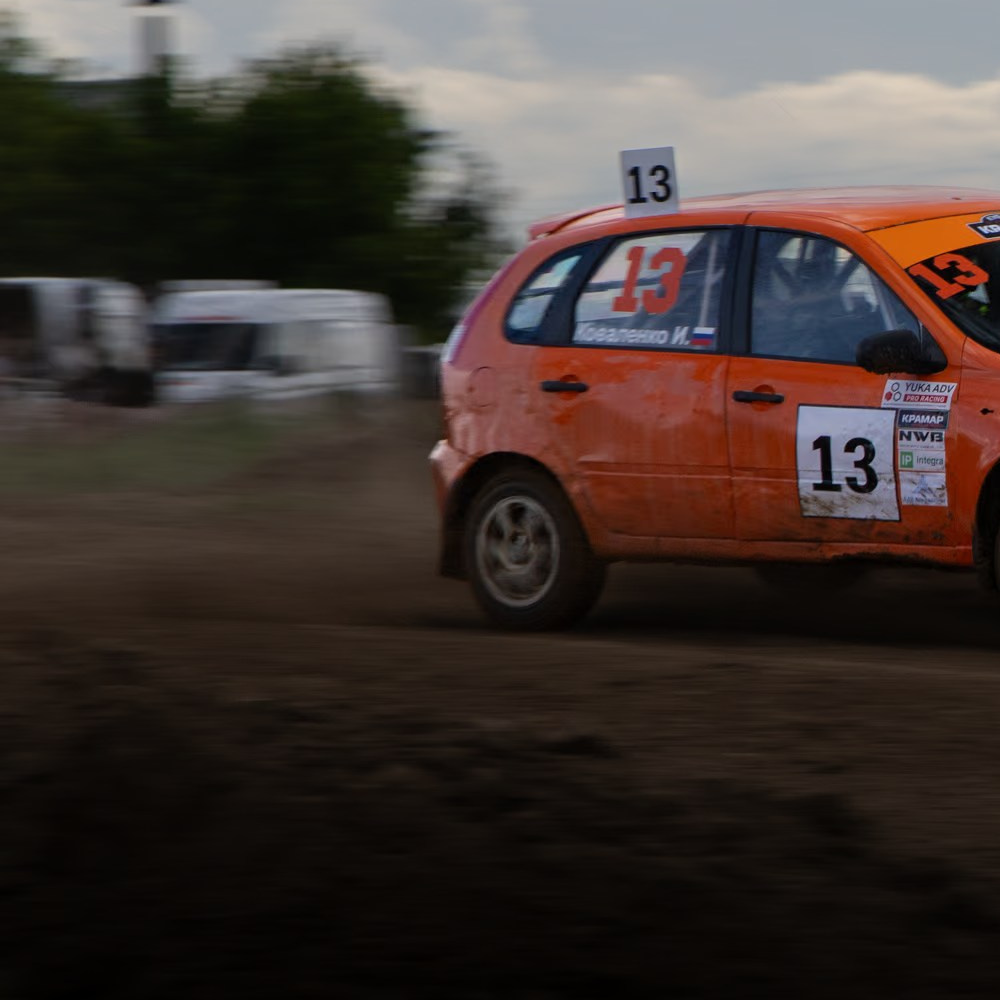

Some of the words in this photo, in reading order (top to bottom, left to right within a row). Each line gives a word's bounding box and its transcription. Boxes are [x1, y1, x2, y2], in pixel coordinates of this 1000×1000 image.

[627, 165, 672, 203] 13
[611, 246, 688, 314] 13
[909, 253, 989, 300] 13
[671, 326, 690, 345] И.
[905, 382, 931, 393] YUKA
[932, 383, 955, 393] ADV
[902, 414, 944, 424] КРАМАР
[900, 430, 943, 442] NWB
[813, 435, 878, 493] 13
[902, 455, 912, 466] IP
[916, 456, 944, 466] integra
